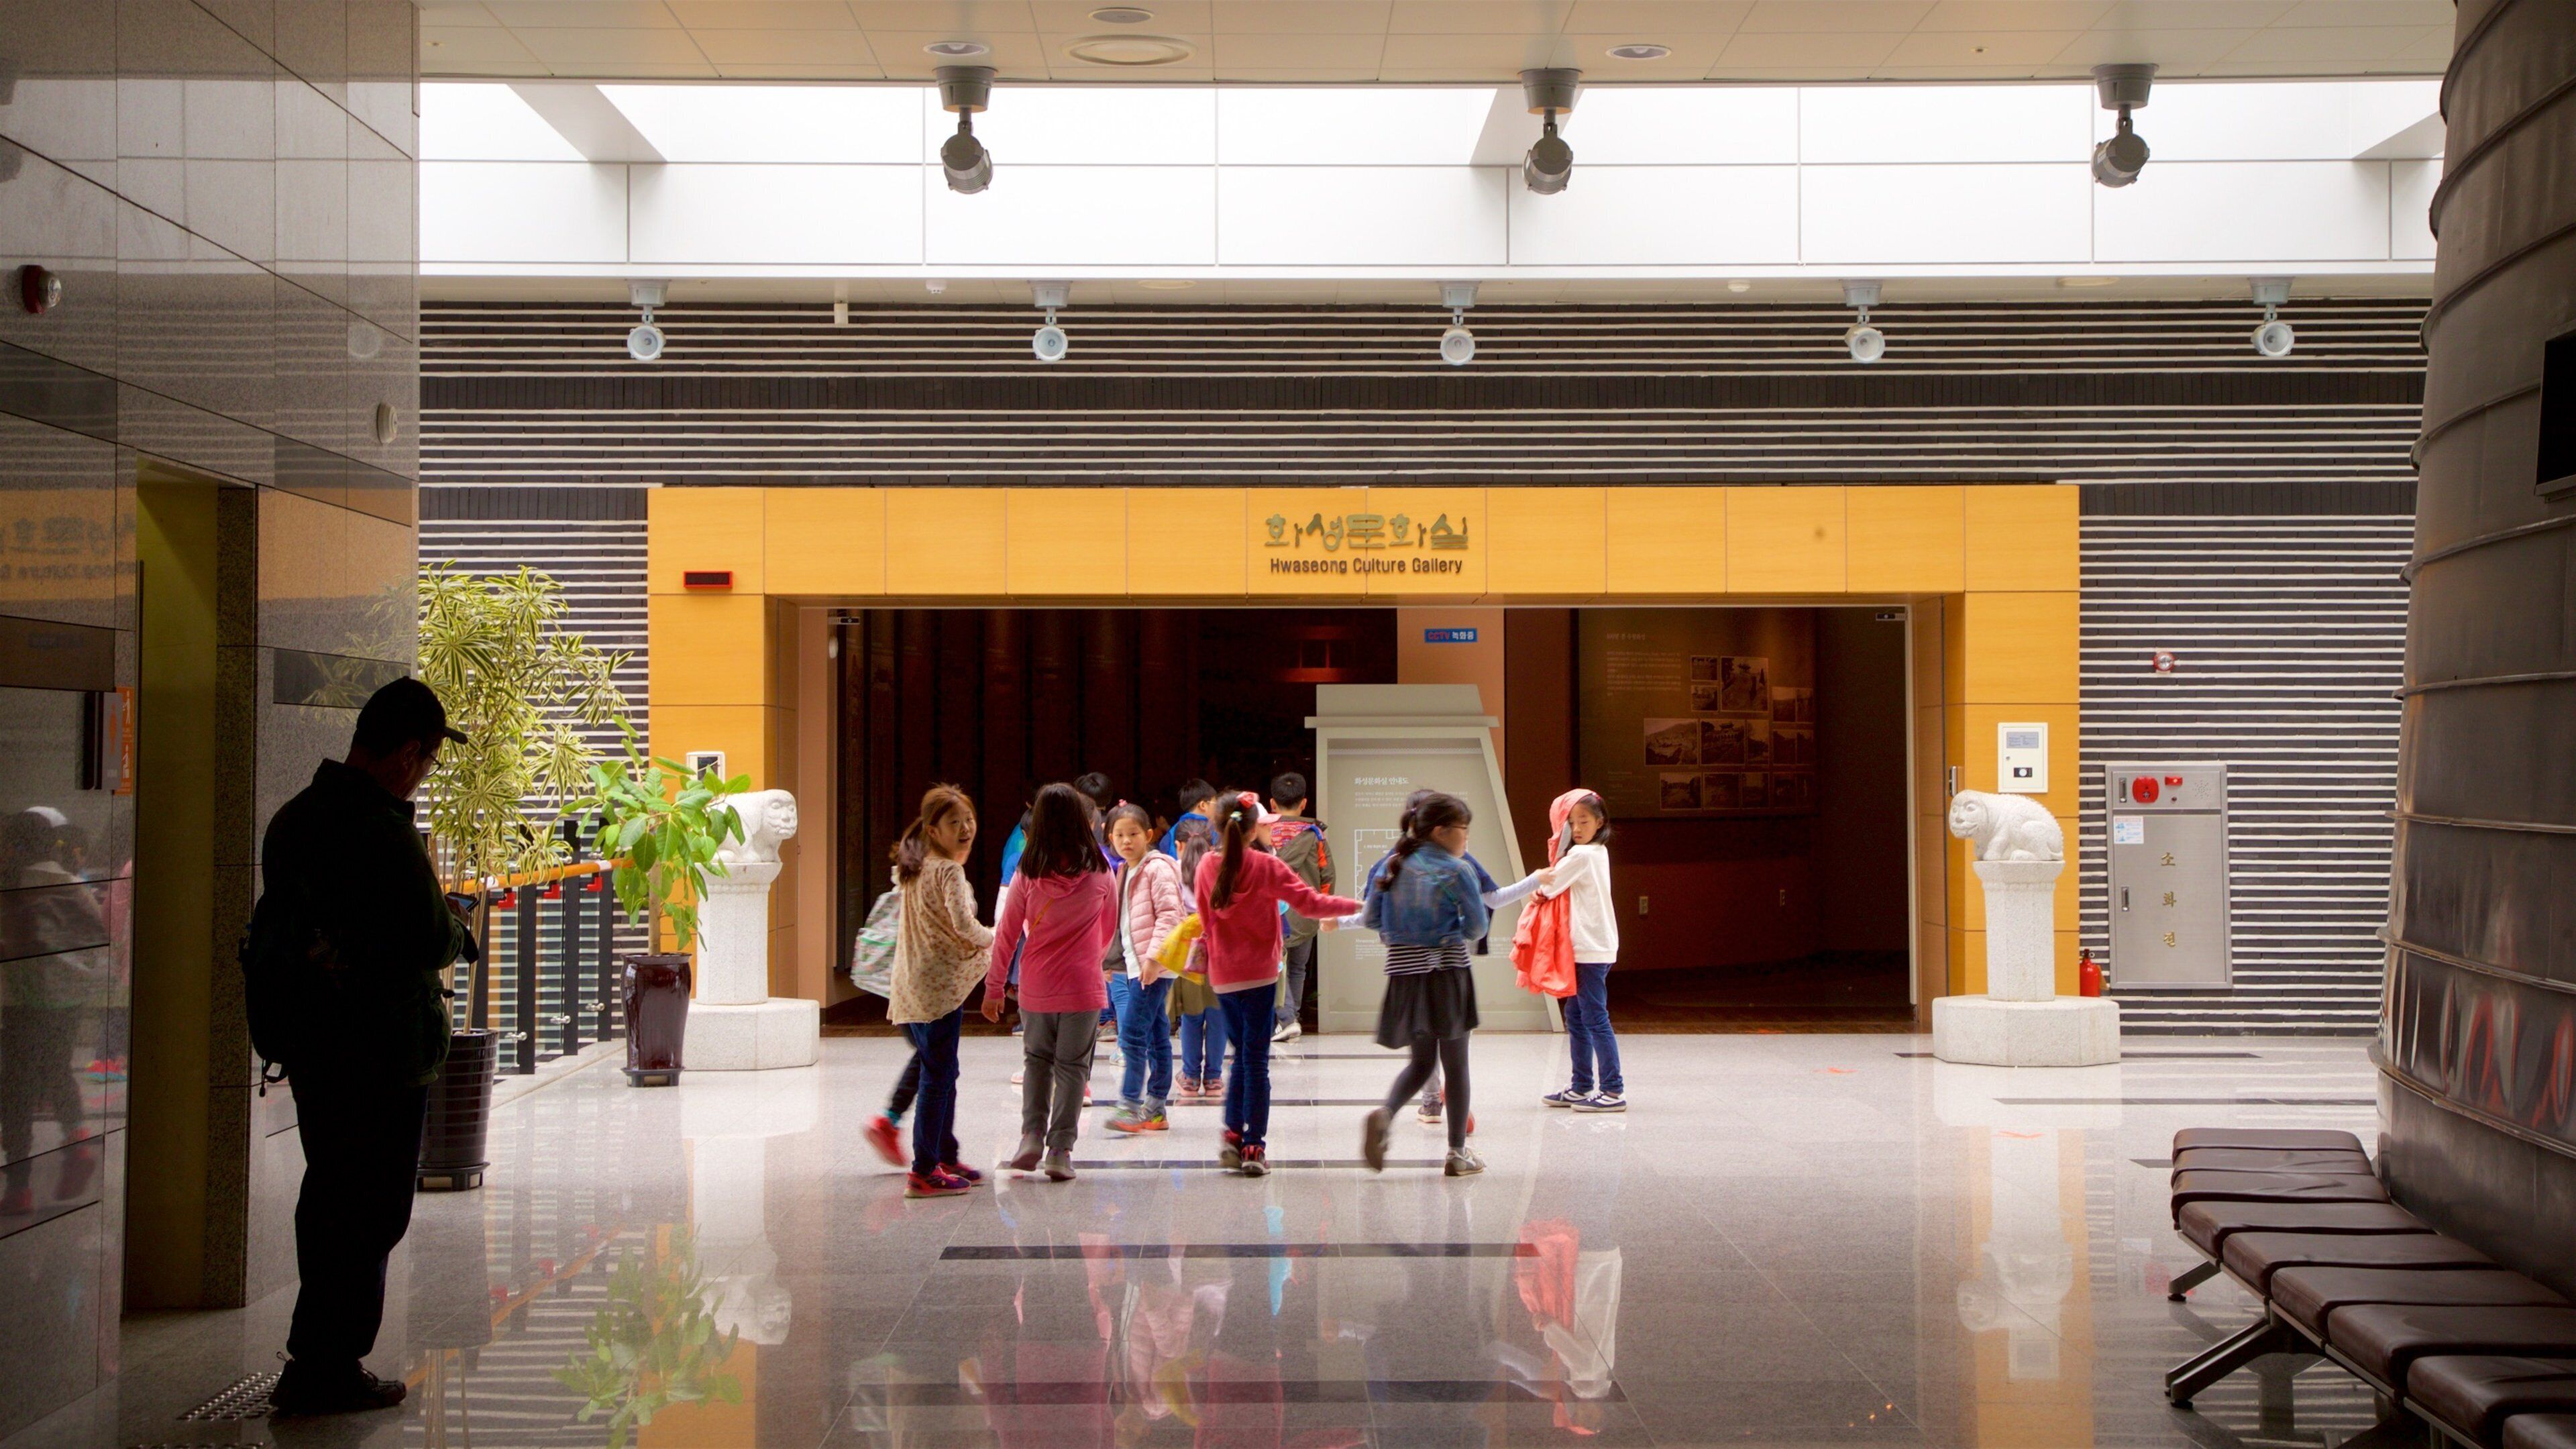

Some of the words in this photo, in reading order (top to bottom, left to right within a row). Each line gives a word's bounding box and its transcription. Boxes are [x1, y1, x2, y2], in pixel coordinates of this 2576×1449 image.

[1265, 513, 1468, 551] 화성문화실
[1271, 558, 1347, 574] Hwaseong
[1353, 557, 1406, 573] Culture
[1412, 557, 1462, 574] Gallery
[1428, 631, 1450, 640] CCTV
